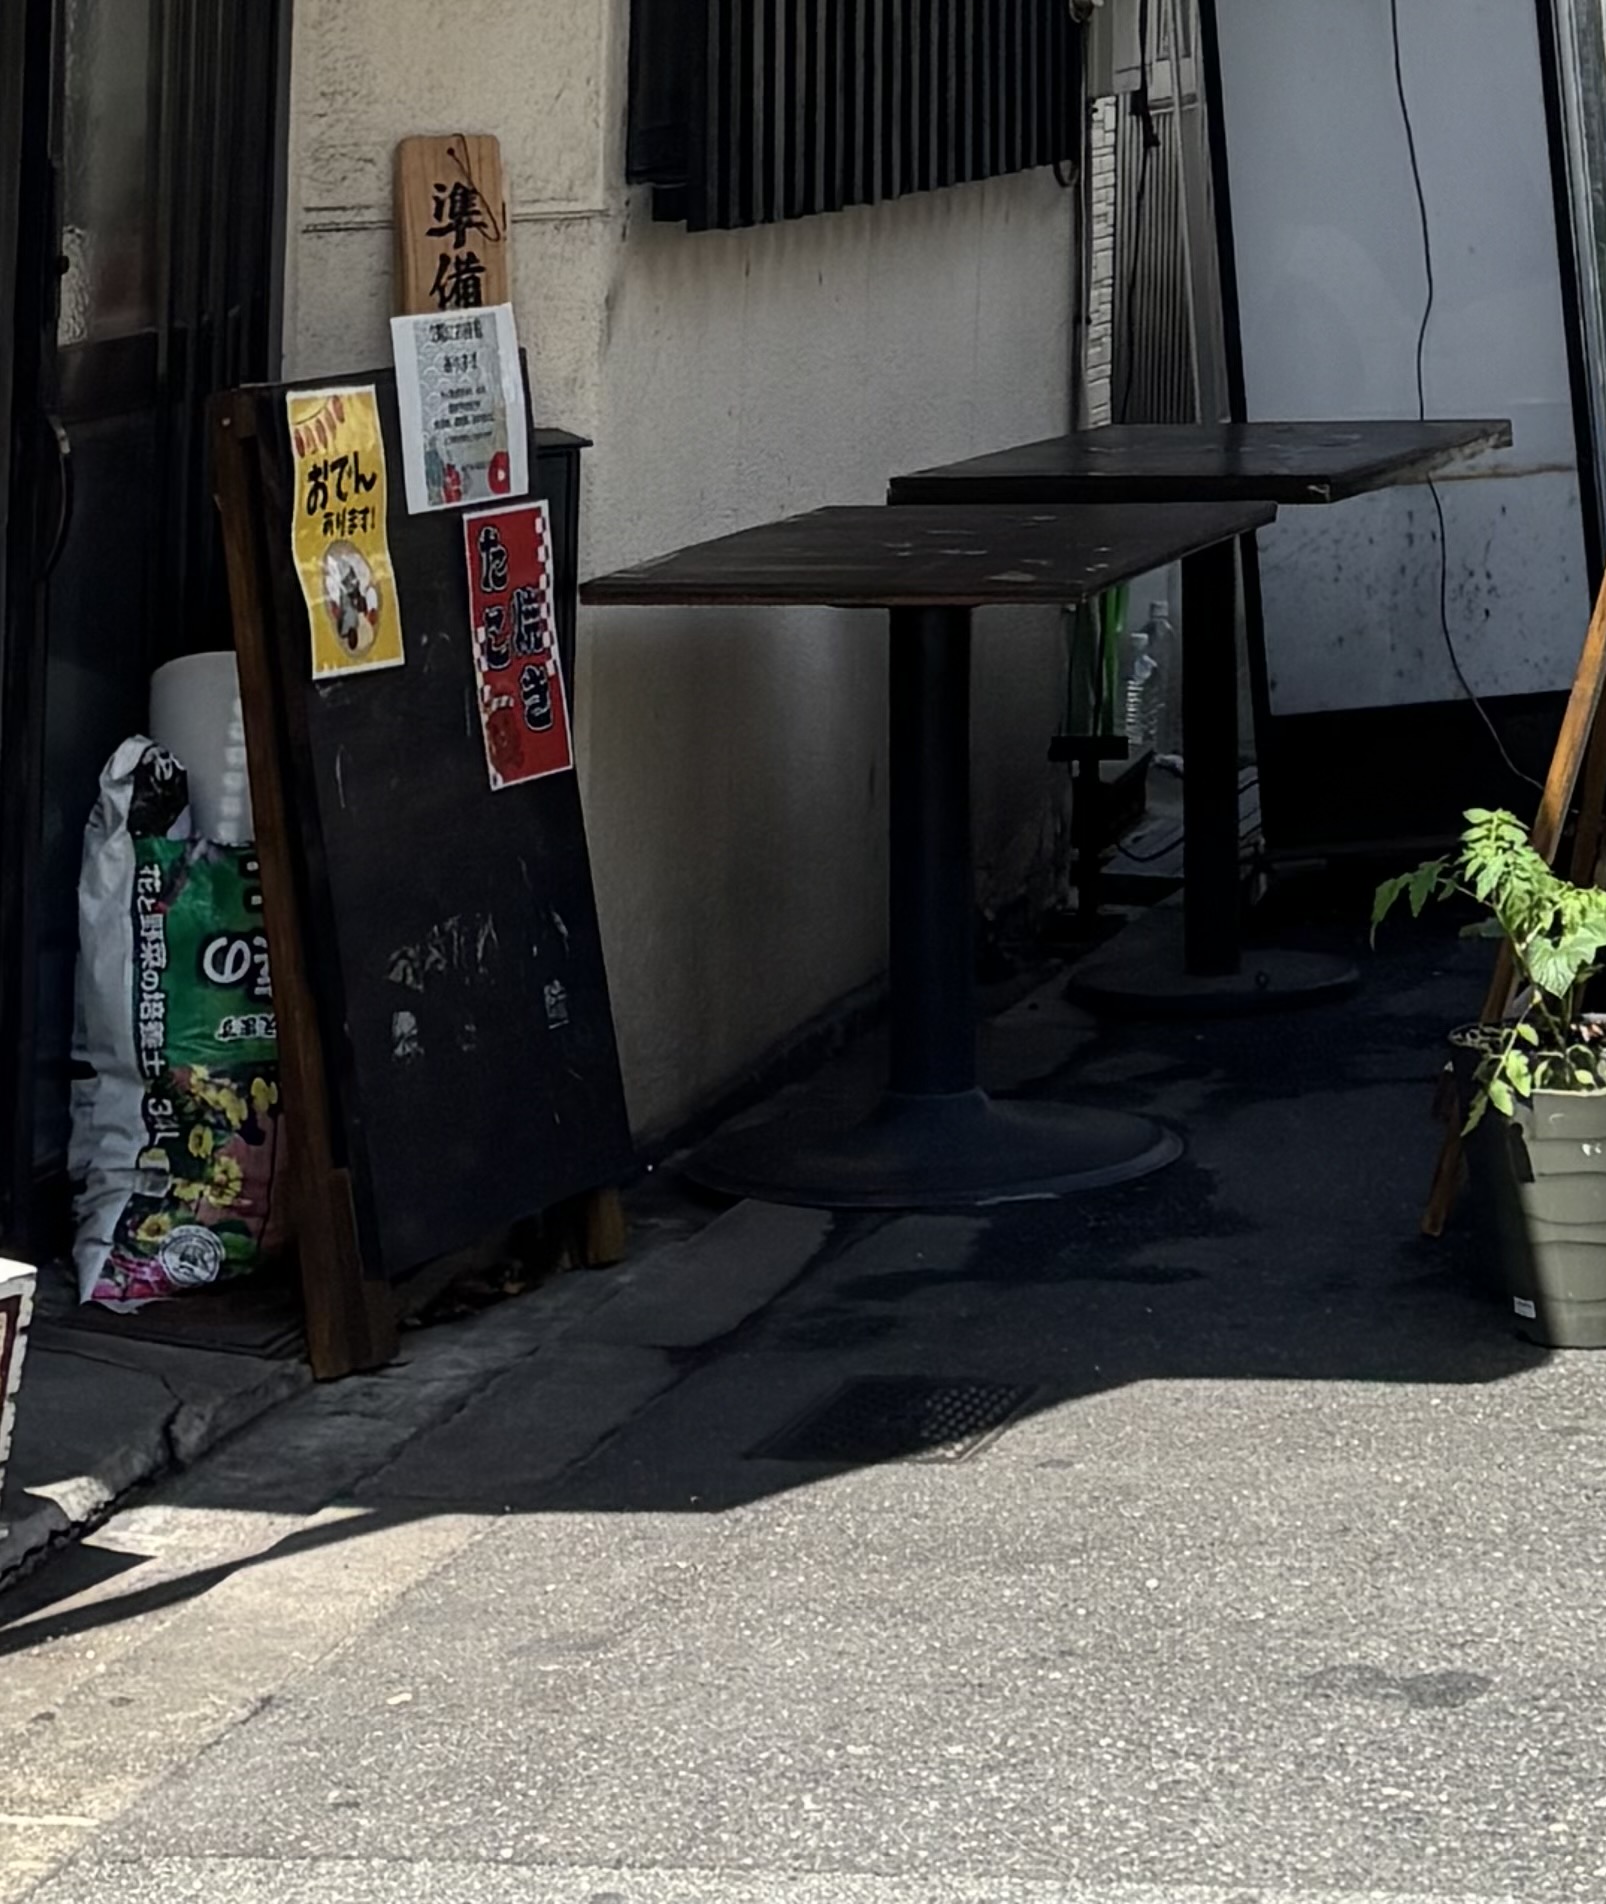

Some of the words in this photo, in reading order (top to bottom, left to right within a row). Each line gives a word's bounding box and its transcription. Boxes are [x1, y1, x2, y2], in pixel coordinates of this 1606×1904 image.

[426, 180, 488, 311] 準備
[306, 449, 377, 517] おでん
[477, 525, 511, 670] たこ
[136, 862, 169, 1078] 花と野菜の培養土
